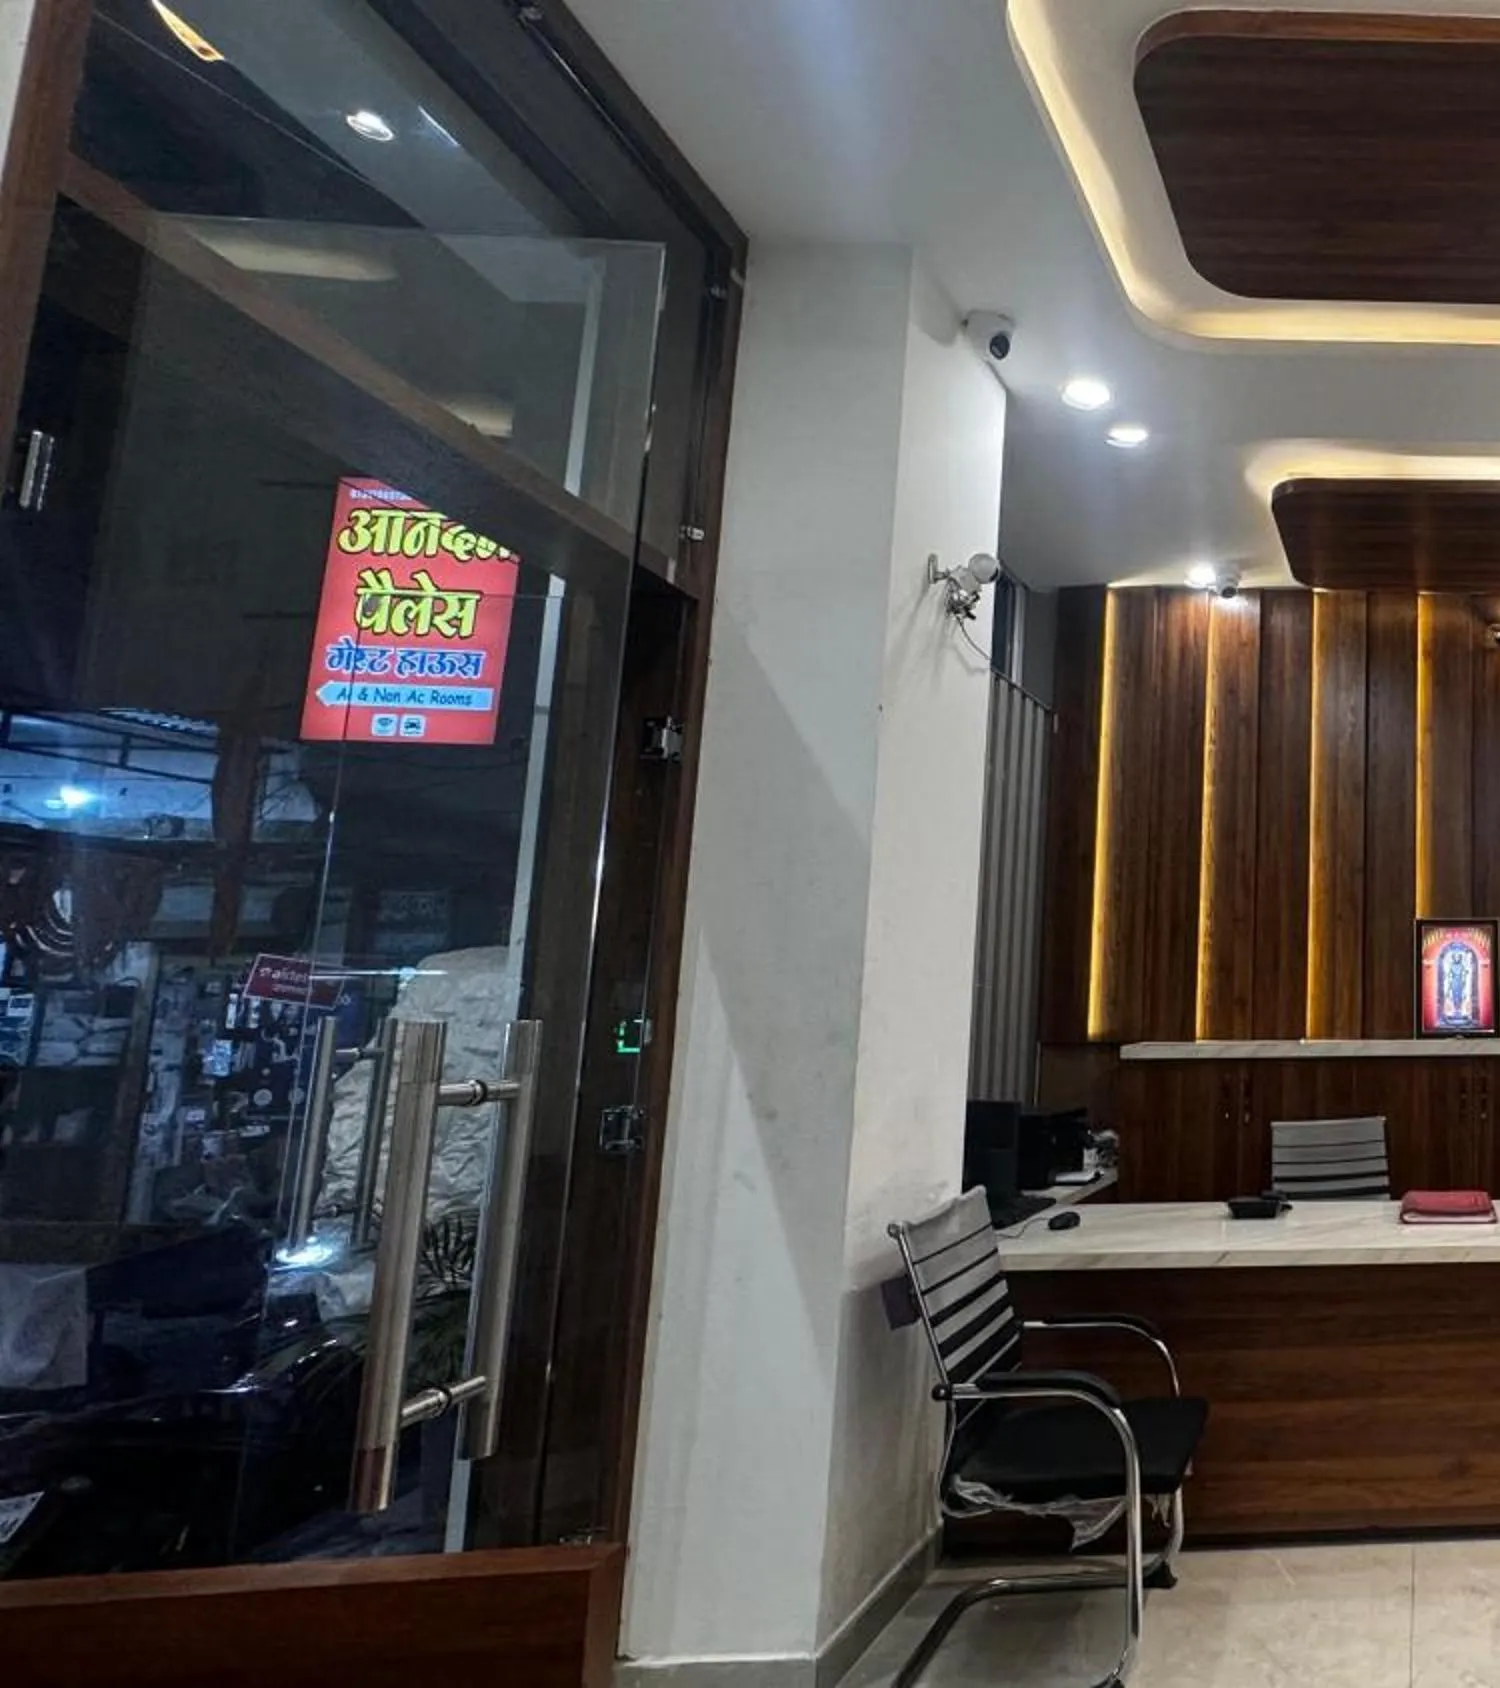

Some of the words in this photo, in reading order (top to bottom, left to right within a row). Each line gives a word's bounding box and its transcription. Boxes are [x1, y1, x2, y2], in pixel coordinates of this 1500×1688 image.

[356, 568, 481, 637] पैलेस
[326, 636, 393, 673] गेस्ट
[357, 688, 368, 701] &
[373, 687, 401, 703] Non
[407, 690, 425, 703] Ac
[430, 690, 474, 705] Rooms
